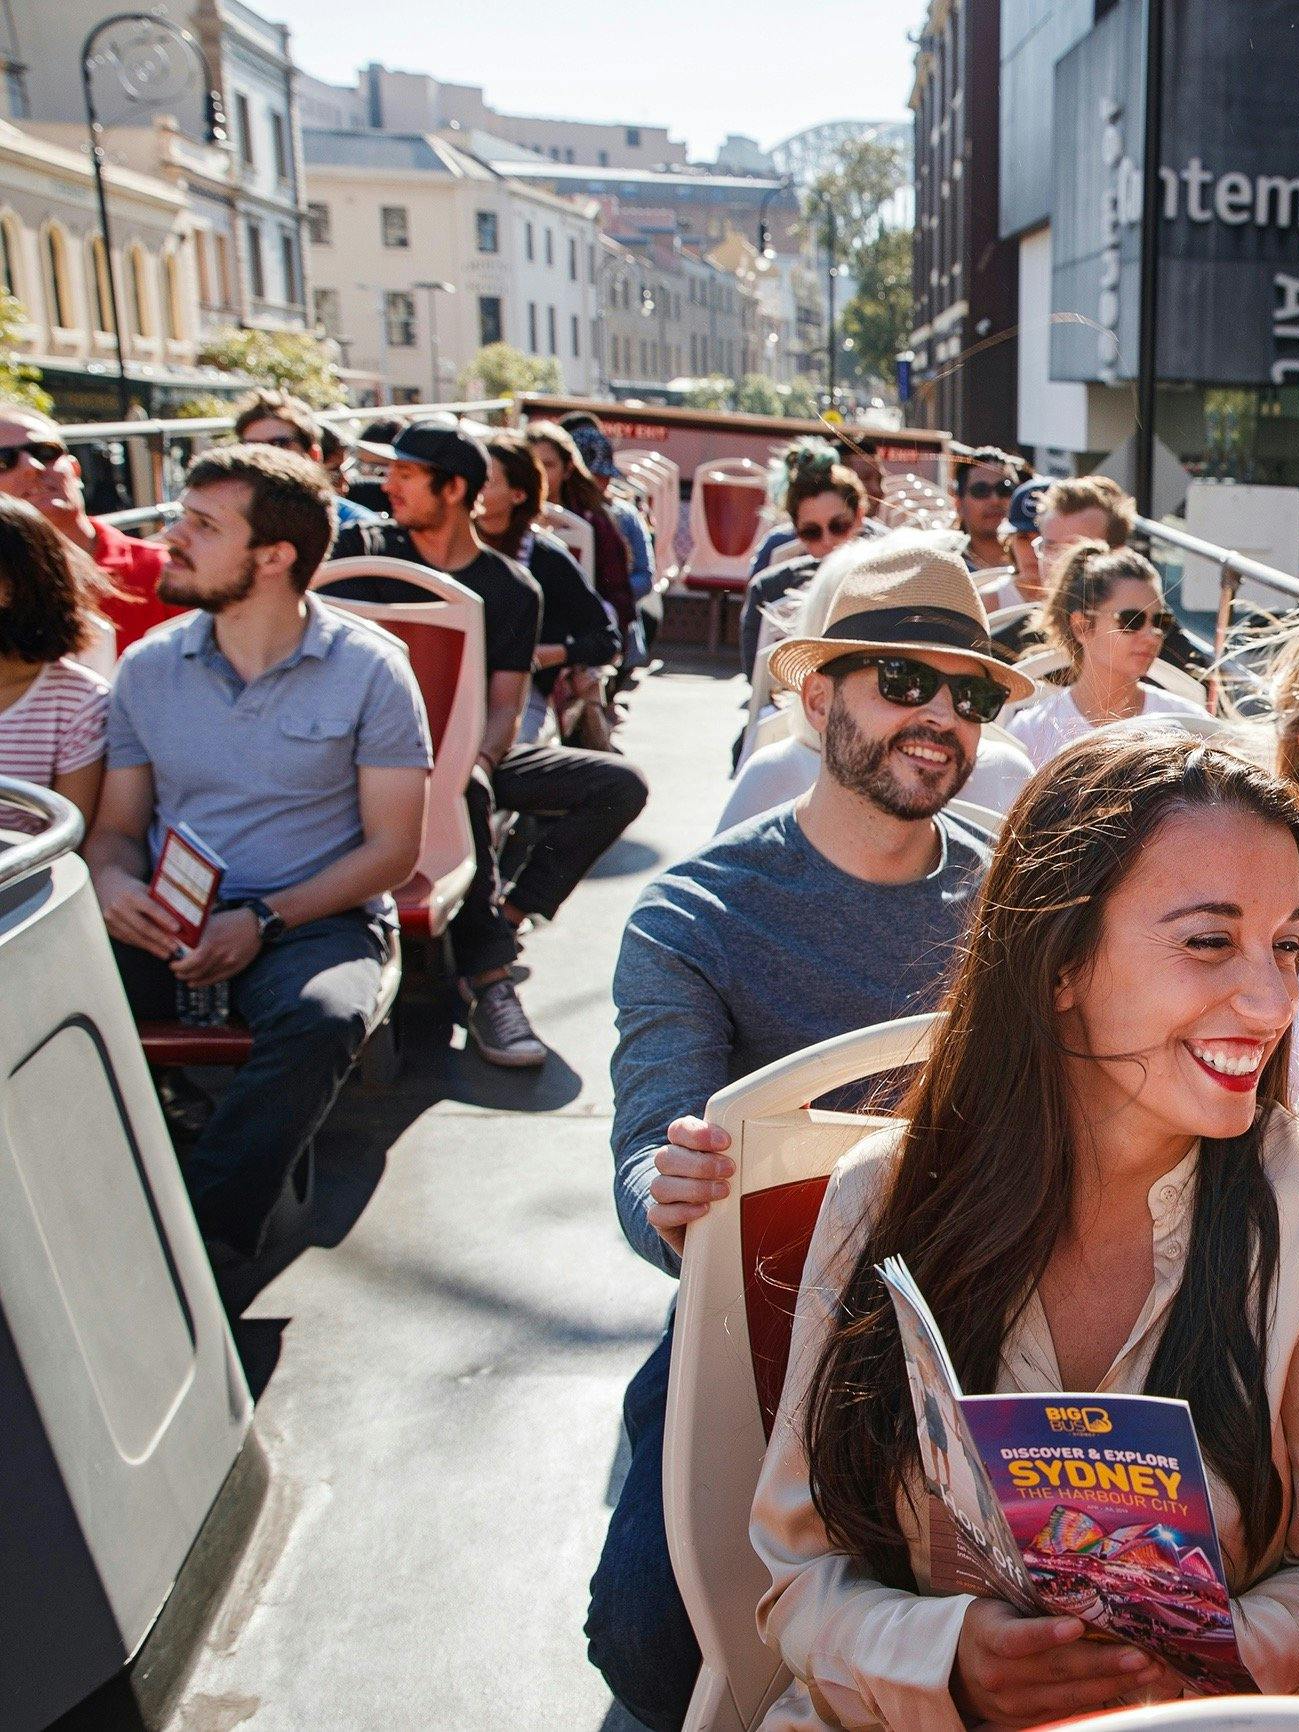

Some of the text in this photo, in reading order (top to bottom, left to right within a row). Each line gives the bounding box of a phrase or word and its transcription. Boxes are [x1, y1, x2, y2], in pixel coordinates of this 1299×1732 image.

[1045, 1406, 1082, 1422] BIG
[1051, 1420, 1087, 1433] BUS
[1000, 1447, 1180, 1471] DISCOVER & EXPLORE
[1008, 1459, 1182, 1501] SYDNEY
[1017, 1487, 1188, 1518] THE HARBOUR CITY
